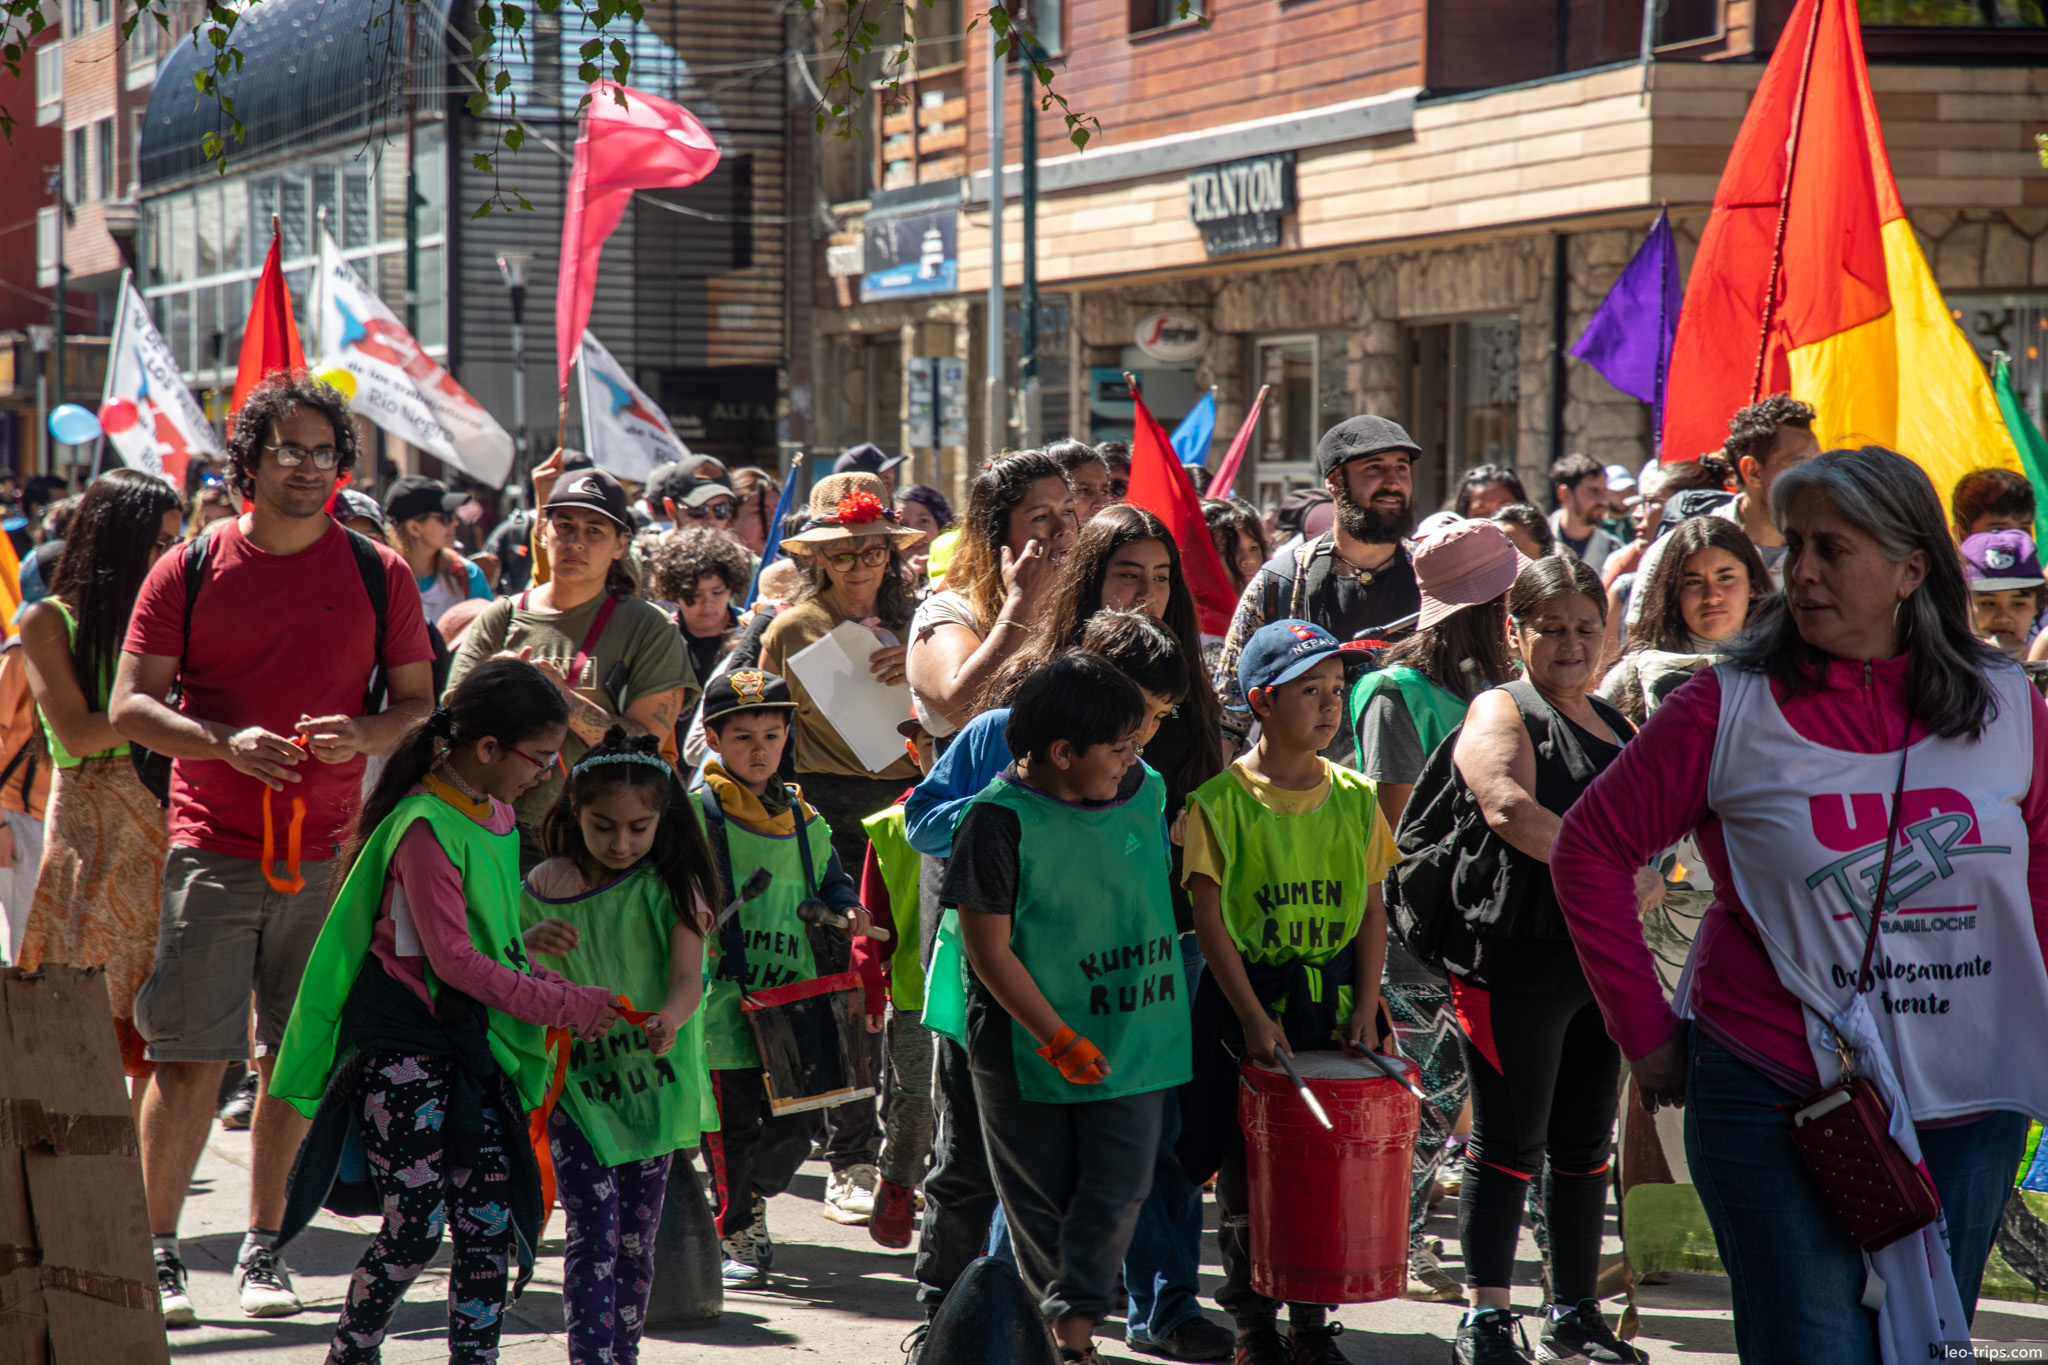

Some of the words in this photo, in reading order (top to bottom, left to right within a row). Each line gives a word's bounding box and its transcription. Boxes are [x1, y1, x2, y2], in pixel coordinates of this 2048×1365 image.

[403, 406, 456, 443] Negro
[1292, 637, 1334, 656] NEPAL
[1253, 880, 1343, 916] KUMEN
[1262, 916, 1346, 949] RUKA
[1880, 915, 1976, 935] BARILOCHE
[1079, 934, 1172, 982] KUMEN
[1090, 973, 1175, 1015] RUKA
[470, 1270, 498, 1280] PARTY
